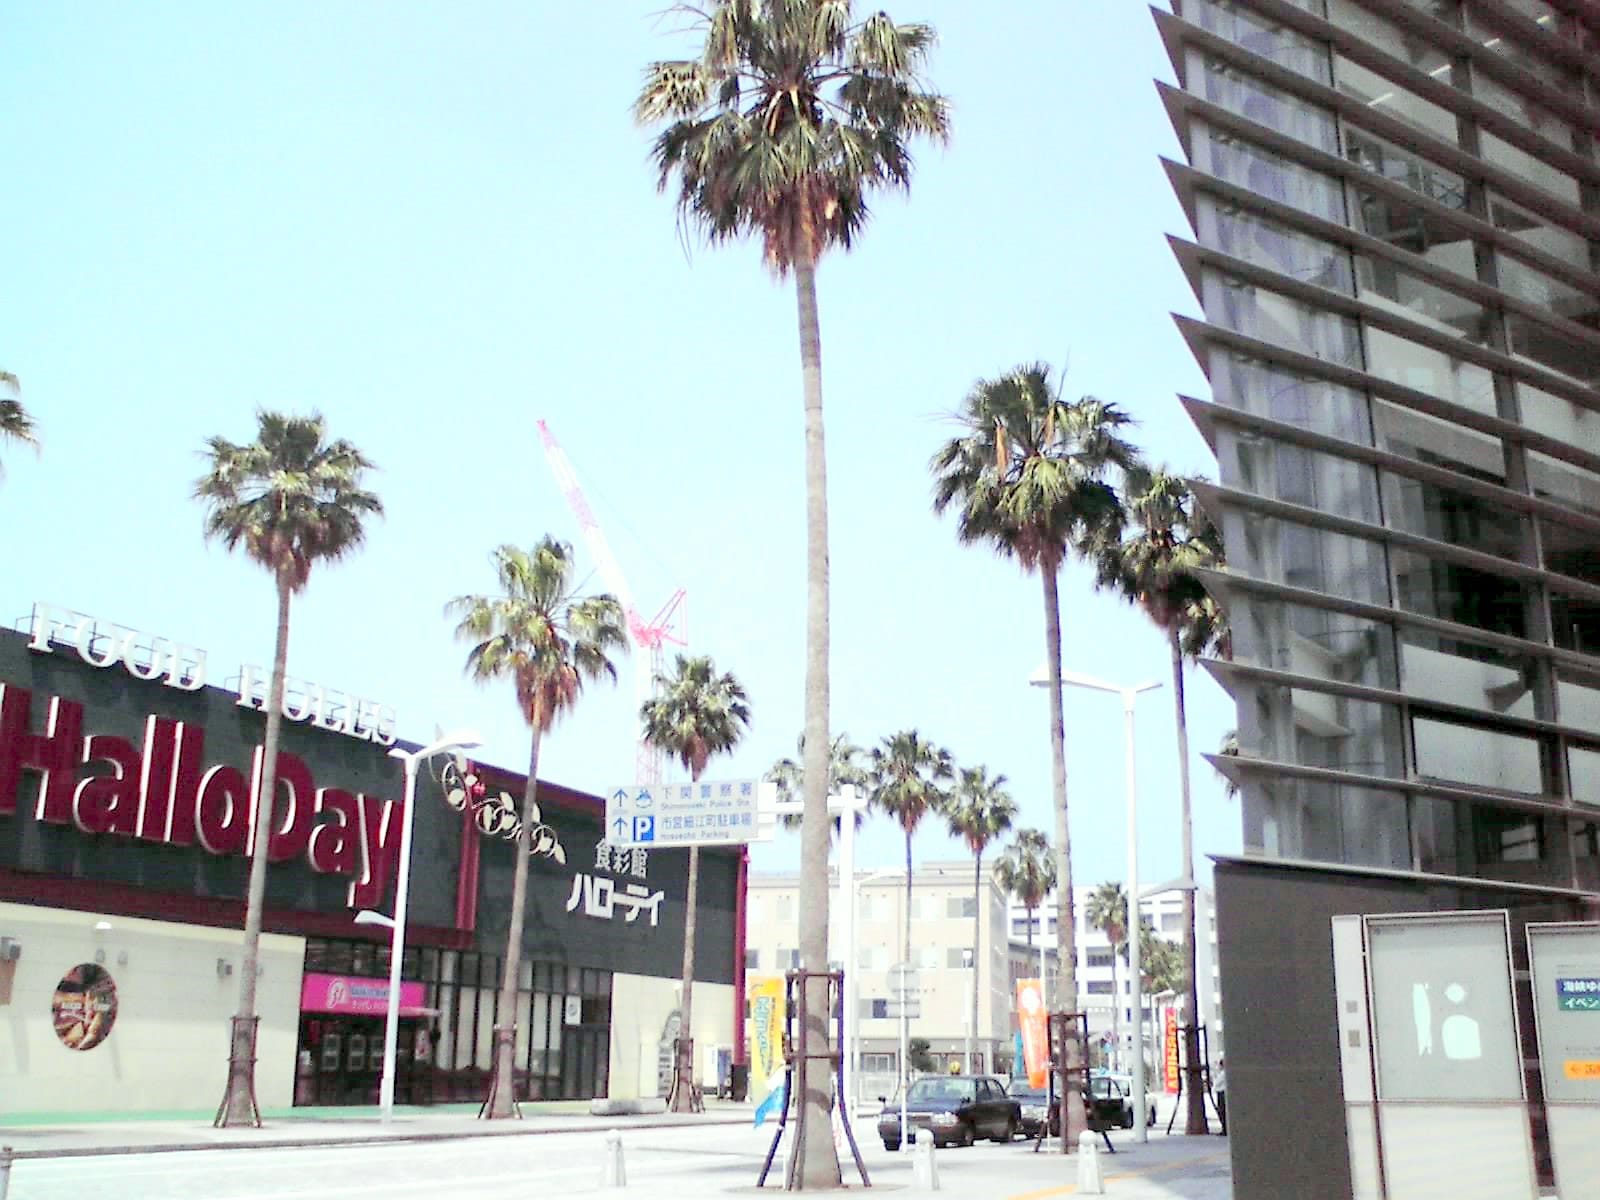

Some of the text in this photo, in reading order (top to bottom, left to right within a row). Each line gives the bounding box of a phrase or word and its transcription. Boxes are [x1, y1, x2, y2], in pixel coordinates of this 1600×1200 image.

[27, 601, 207, 691] FOOD
[0, 681, 404, 909] HalloDay
[635, 817, 652, 841] P
